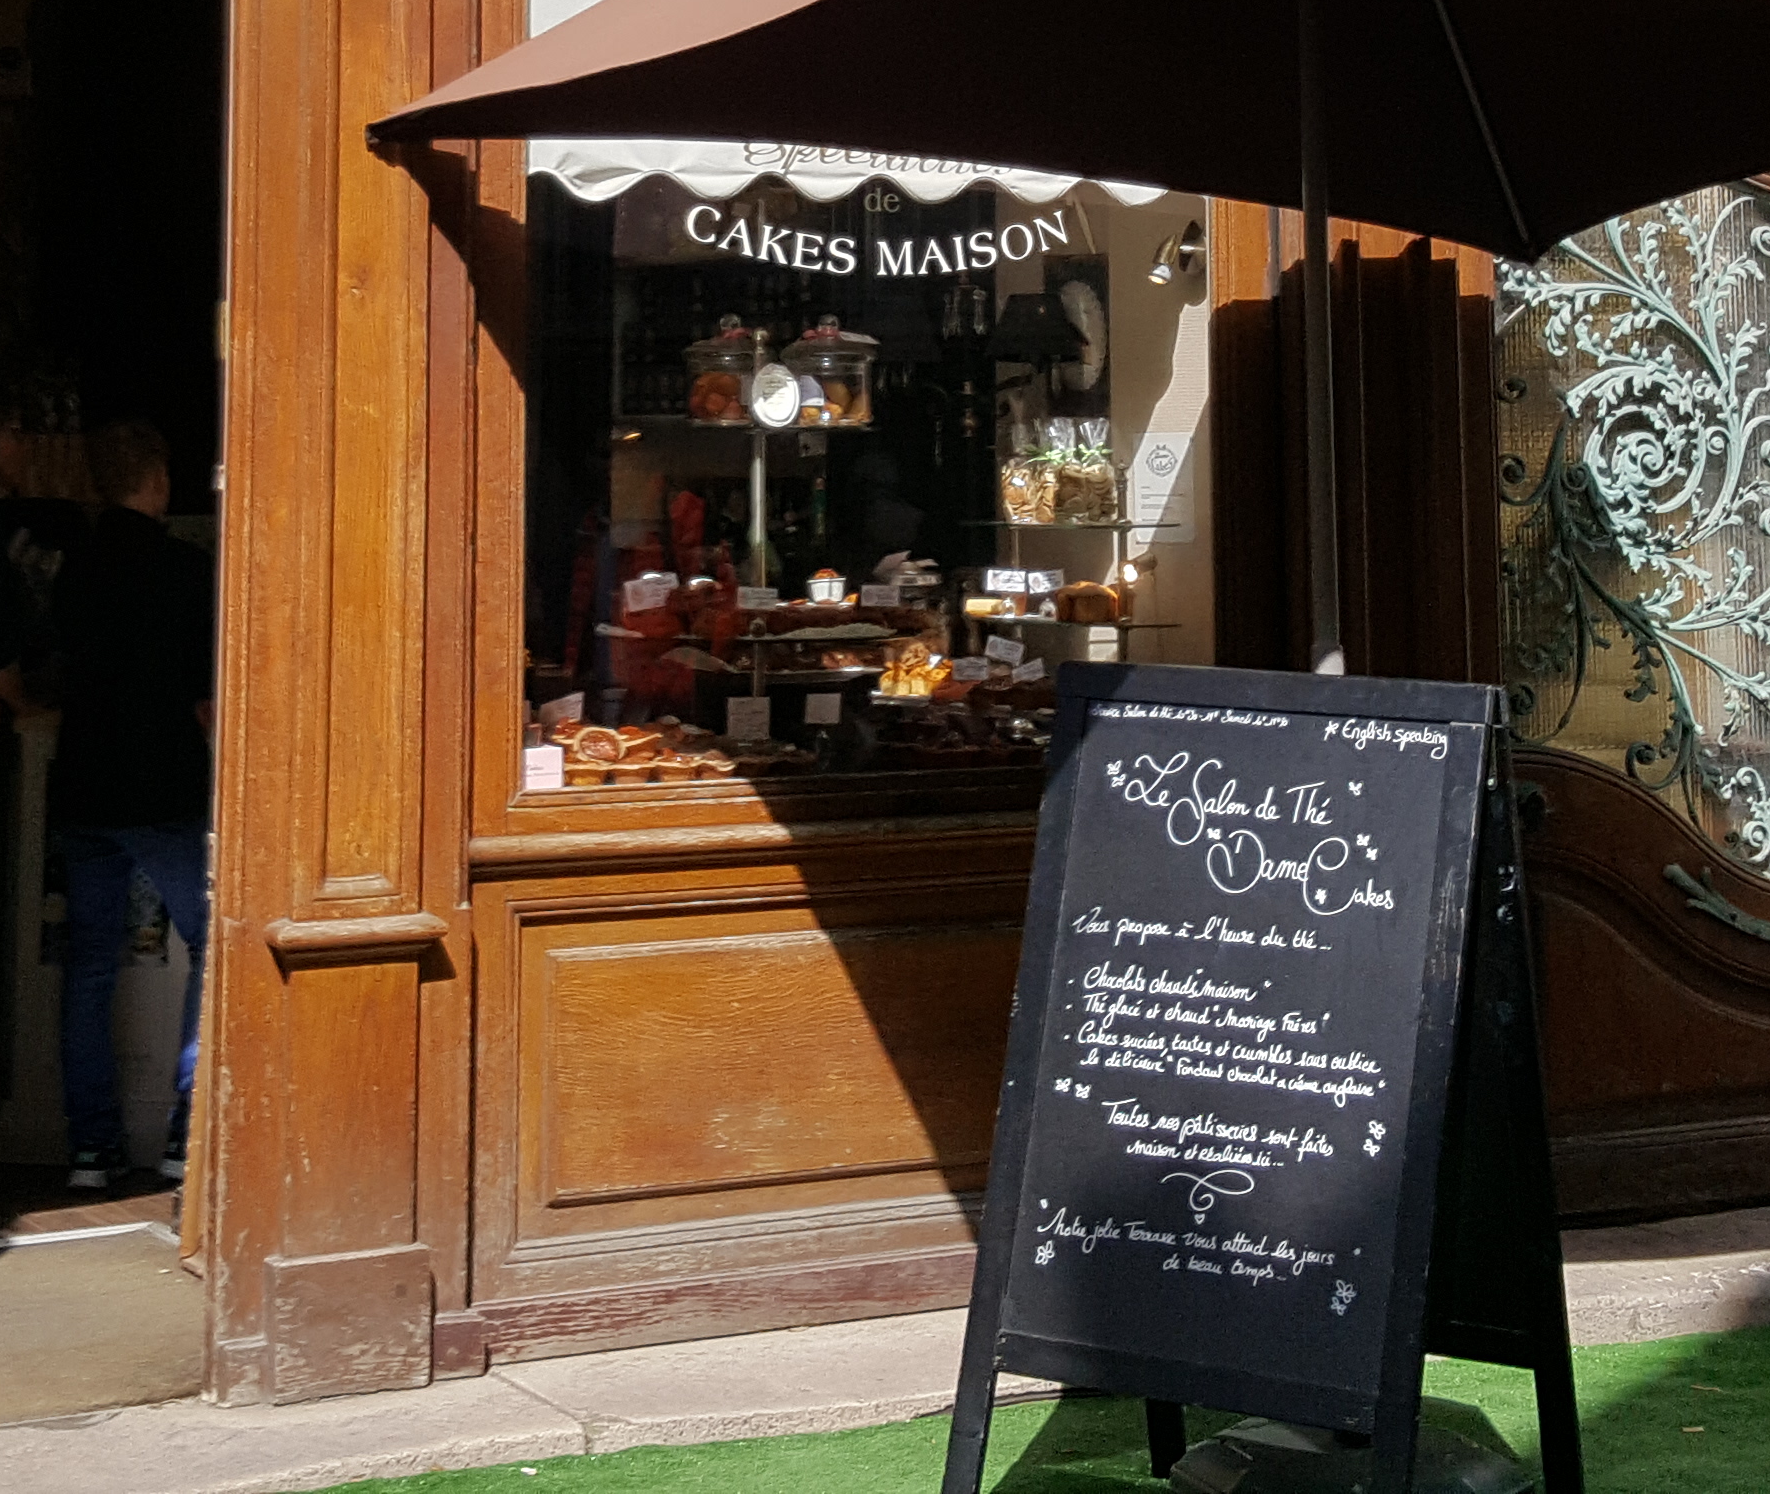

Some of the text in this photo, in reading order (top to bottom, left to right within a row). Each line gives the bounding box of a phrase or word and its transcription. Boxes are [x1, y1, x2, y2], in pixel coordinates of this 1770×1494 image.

[863, 187, 901, 214] de
[684, 204, 1069, 278] CAKES MAISON
[1341, 717, 1448, 760] English speaking
[1124, 751, 1333, 846] Le Salon de Thé
[1206, 829, 1395, 916] Dame Cakes
[1071, 906, 1111, 934] Vous
[1115, 916, 1172, 946] propose
[1174, 921, 1190, 939] à
[1193, 915, 1256, 946] l'heure
[1260, 925, 1287, 948] du
[1083, 960, 1147, 993] Chocolats
[1083, 991, 1110, 1014] Thé
[1102, 993, 1144, 1029] glacé
[1145, 1002, 1161, 1019] et
[1164, 1001, 1211, 1025] chaud
[1077, 1019, 1119, 1046] Cakes
[1171, 1033, 1212, 1057] tartes
[1214, 1039, 1230, 1057] et
[1232, 1043, 1293, 1066] crumbles
[1293, 1050, 1328, 1069] sans
[1226, 1064, 1278, 1086] chocolat
[1101, 1097, 1334, 1163] Toutes nos pâtisseries sont faites
[1126, 1138, 1181, 1160] maison
[1183, 1142, 1199, 1161] et
[1081, 1217, 1121, 1254] jolie
[1123, 1220, 1177, 1246] Terrasse
[1221, 1231, 1269, 1257] attend
[1270, 1239, 1296, 1261] les
[1291, 1249, 1335, 1276] jours
[1162, 1253, 1181, 1271] de
[1187, 1255, 1223, 1275] beau
